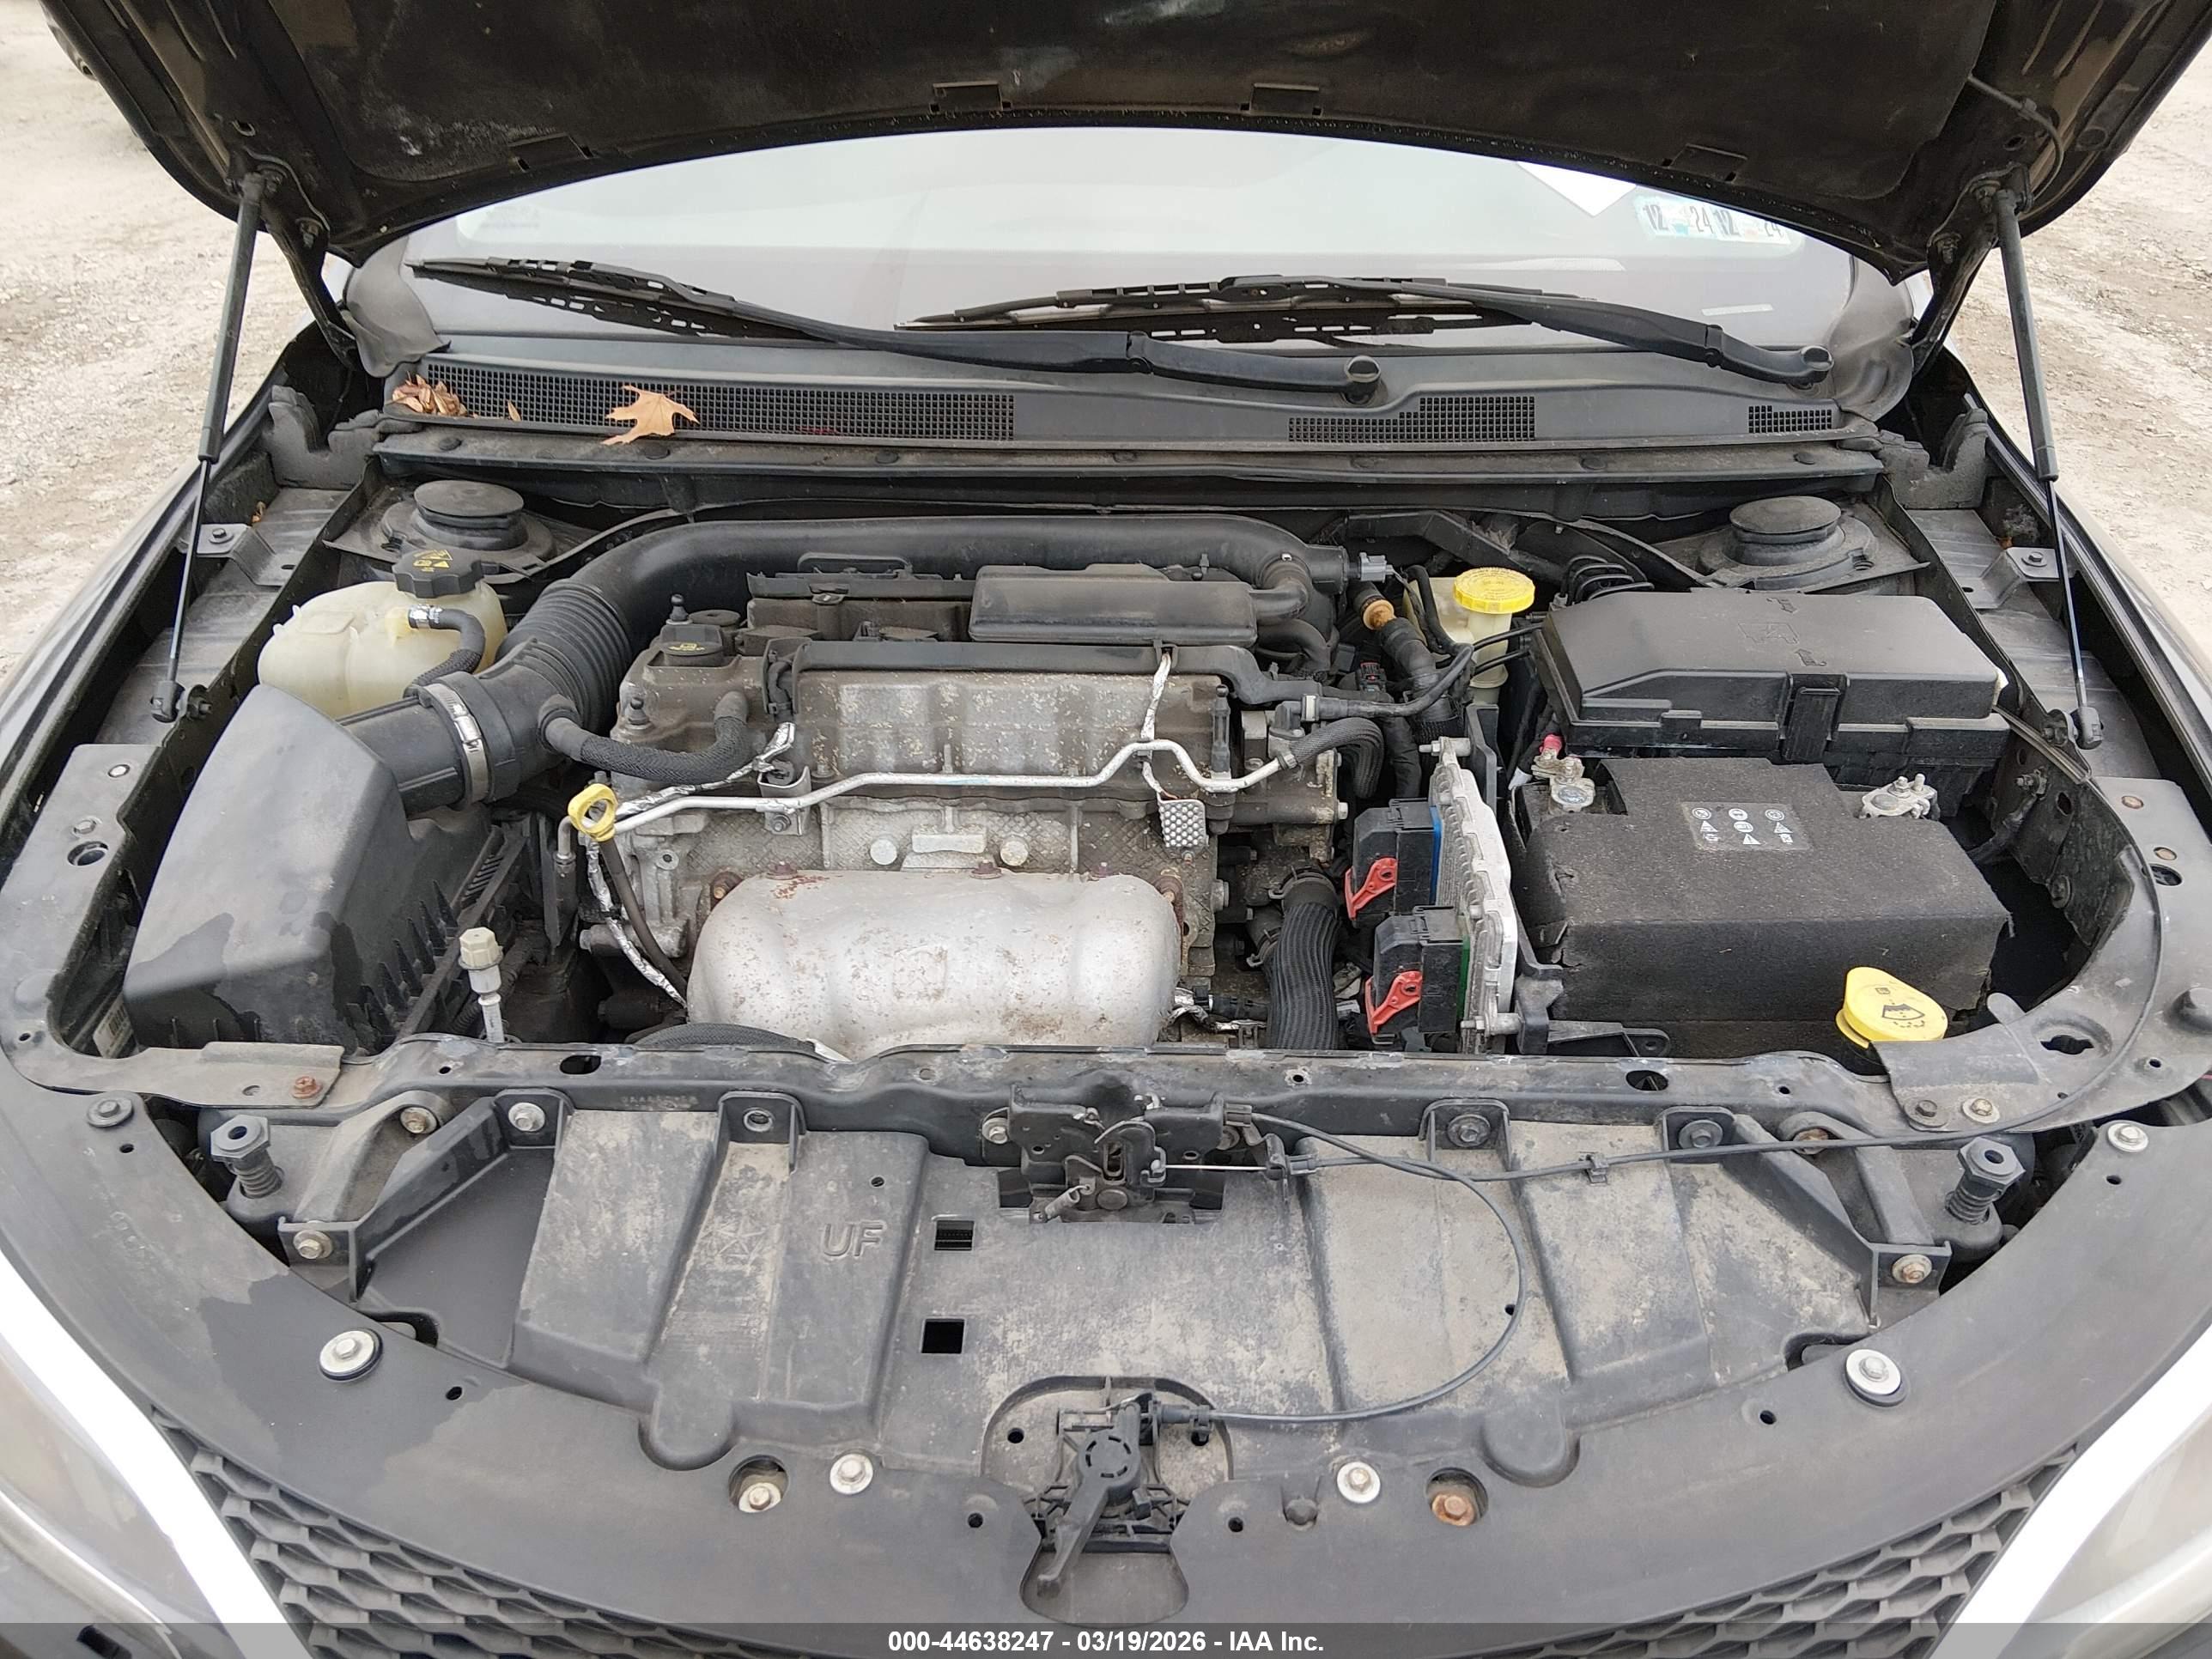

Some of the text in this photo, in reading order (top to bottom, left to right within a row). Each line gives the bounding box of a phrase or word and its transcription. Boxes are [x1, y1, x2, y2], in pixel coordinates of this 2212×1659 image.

[1642, 204, 1714, 234] 12 24
[1713, 210, 1741, 236] 12
[823, 1219, 886, 1258] UF
